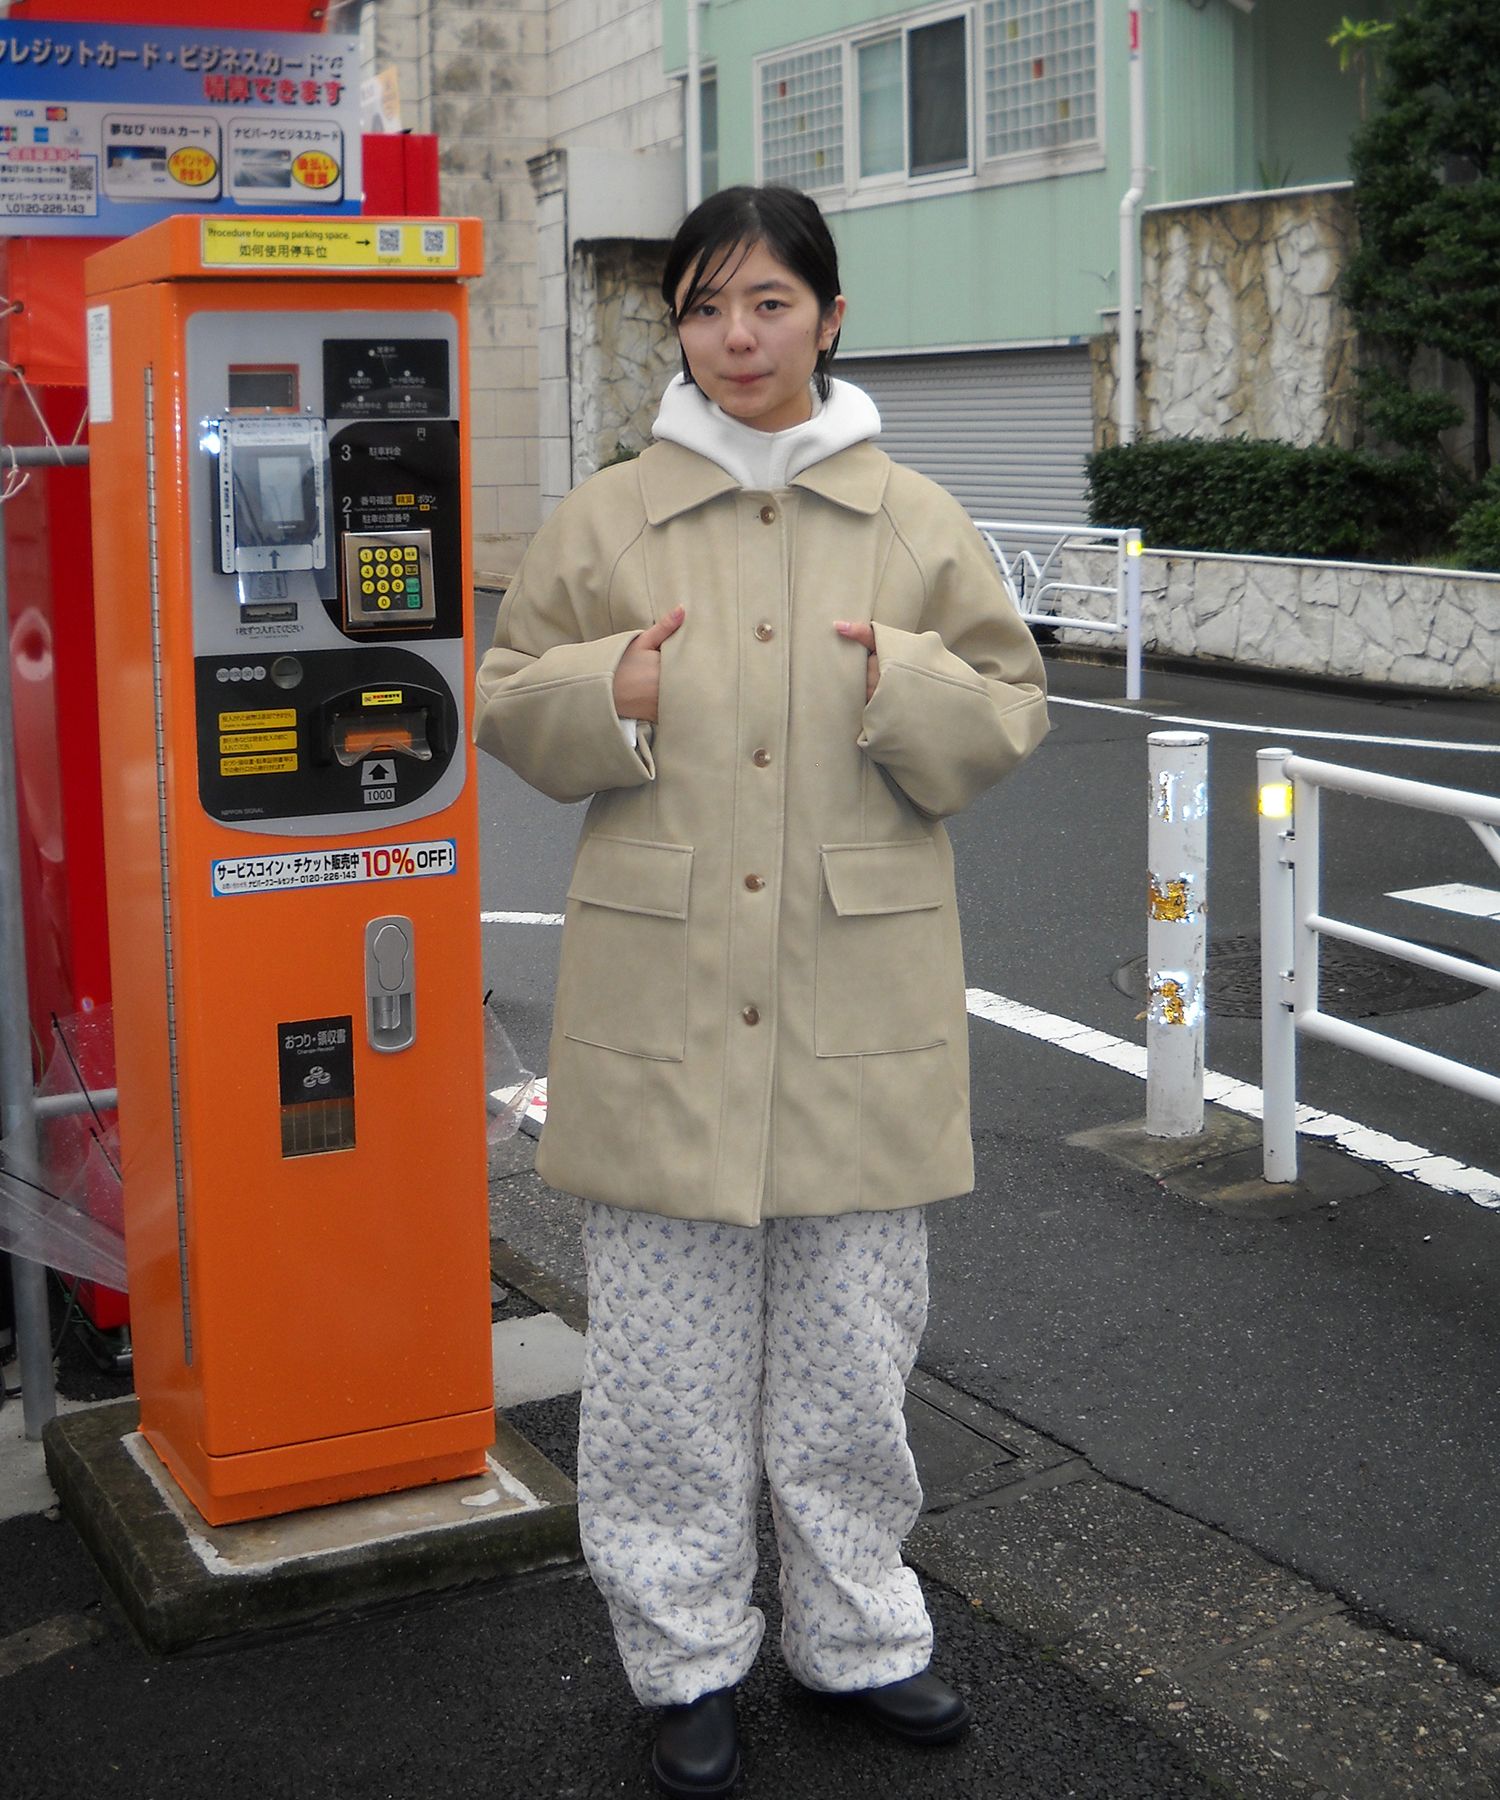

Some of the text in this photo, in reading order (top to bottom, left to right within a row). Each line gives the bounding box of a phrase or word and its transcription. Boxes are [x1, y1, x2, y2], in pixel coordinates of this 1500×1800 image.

[204, 74, 345, 106] 精算できます
[149, 126, 175, 135] VISA
[178, 127, 211, 137] カード
[208, 228, 351, 242] Procedure for using parking space.
[239, 244, 328, 259] 如何使用停车位
[341, 444, 351, 461] 3
[342, 496, 352, 512] 2
[344, 513, 350, 529] 1
[368, 789, 393, 801] 1000
[217, 848, 453, 881] サービスコイン・チケット販売中 10% OFF!
[300, 870, 357, 884] 0120-226-143
[285, 1028, 346, 1049] おつり・領収書
